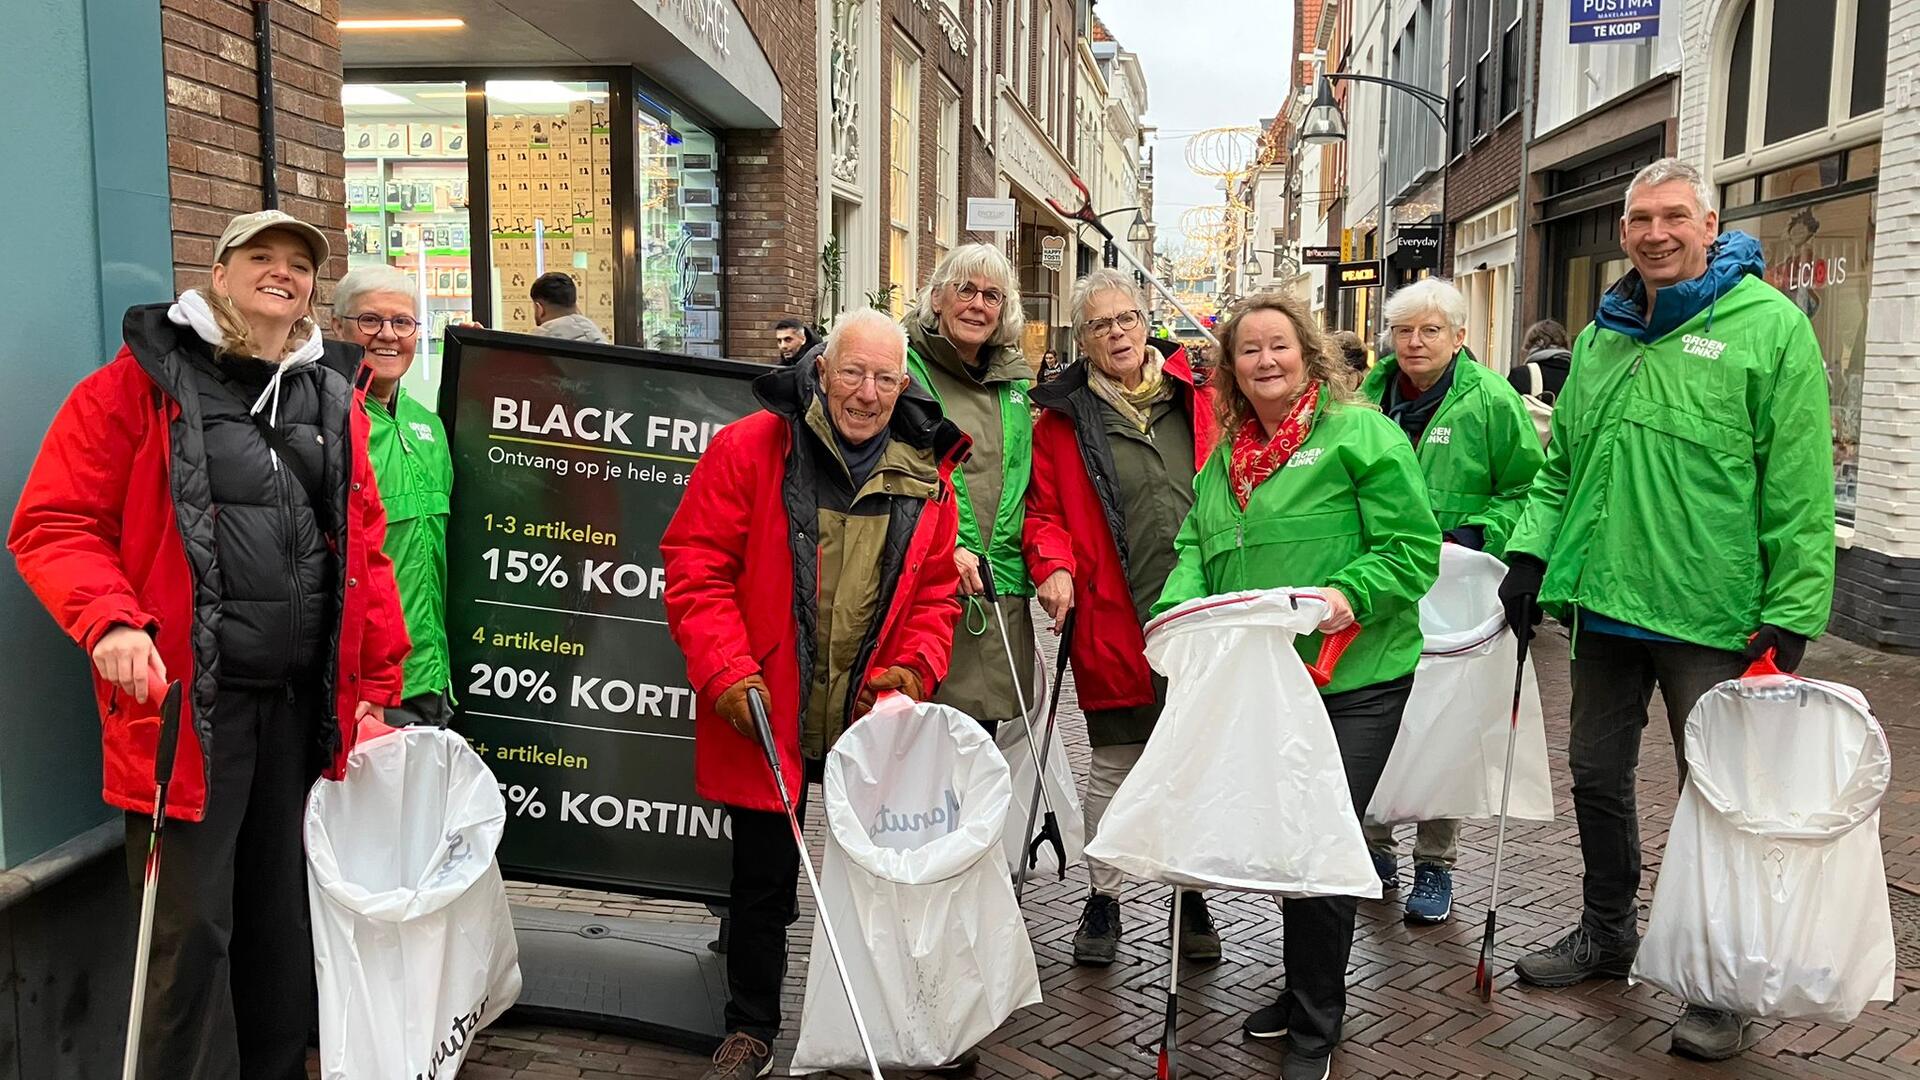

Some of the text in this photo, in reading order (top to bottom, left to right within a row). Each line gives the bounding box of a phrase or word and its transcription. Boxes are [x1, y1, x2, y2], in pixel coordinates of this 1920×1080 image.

[1593, 22, 1641, 37] TE KOOP
[1398, 236, 1438, 248] Everyday
[1681, 334, 1727, 352] GROEN
[1682, 343, 1721, 360] LINKS
[492, 396, 726, 454] BLACK FRI
[488, 446, 569, 476] Ontvang
[575, 461, 599, 479] op
[603, 461, 621, 481] je
[628, 462, 667, 483] hele
[484, 513, 617, 546] 1-3 artikelen
[481, 548, 569, 589] 15%
[472, 626, 585, 656] 4 artikelen
[467, 662, 558, 705] 20%
[496, 745, 588, 769] artikelen
[560, 791, 733, 841] KORTIN
